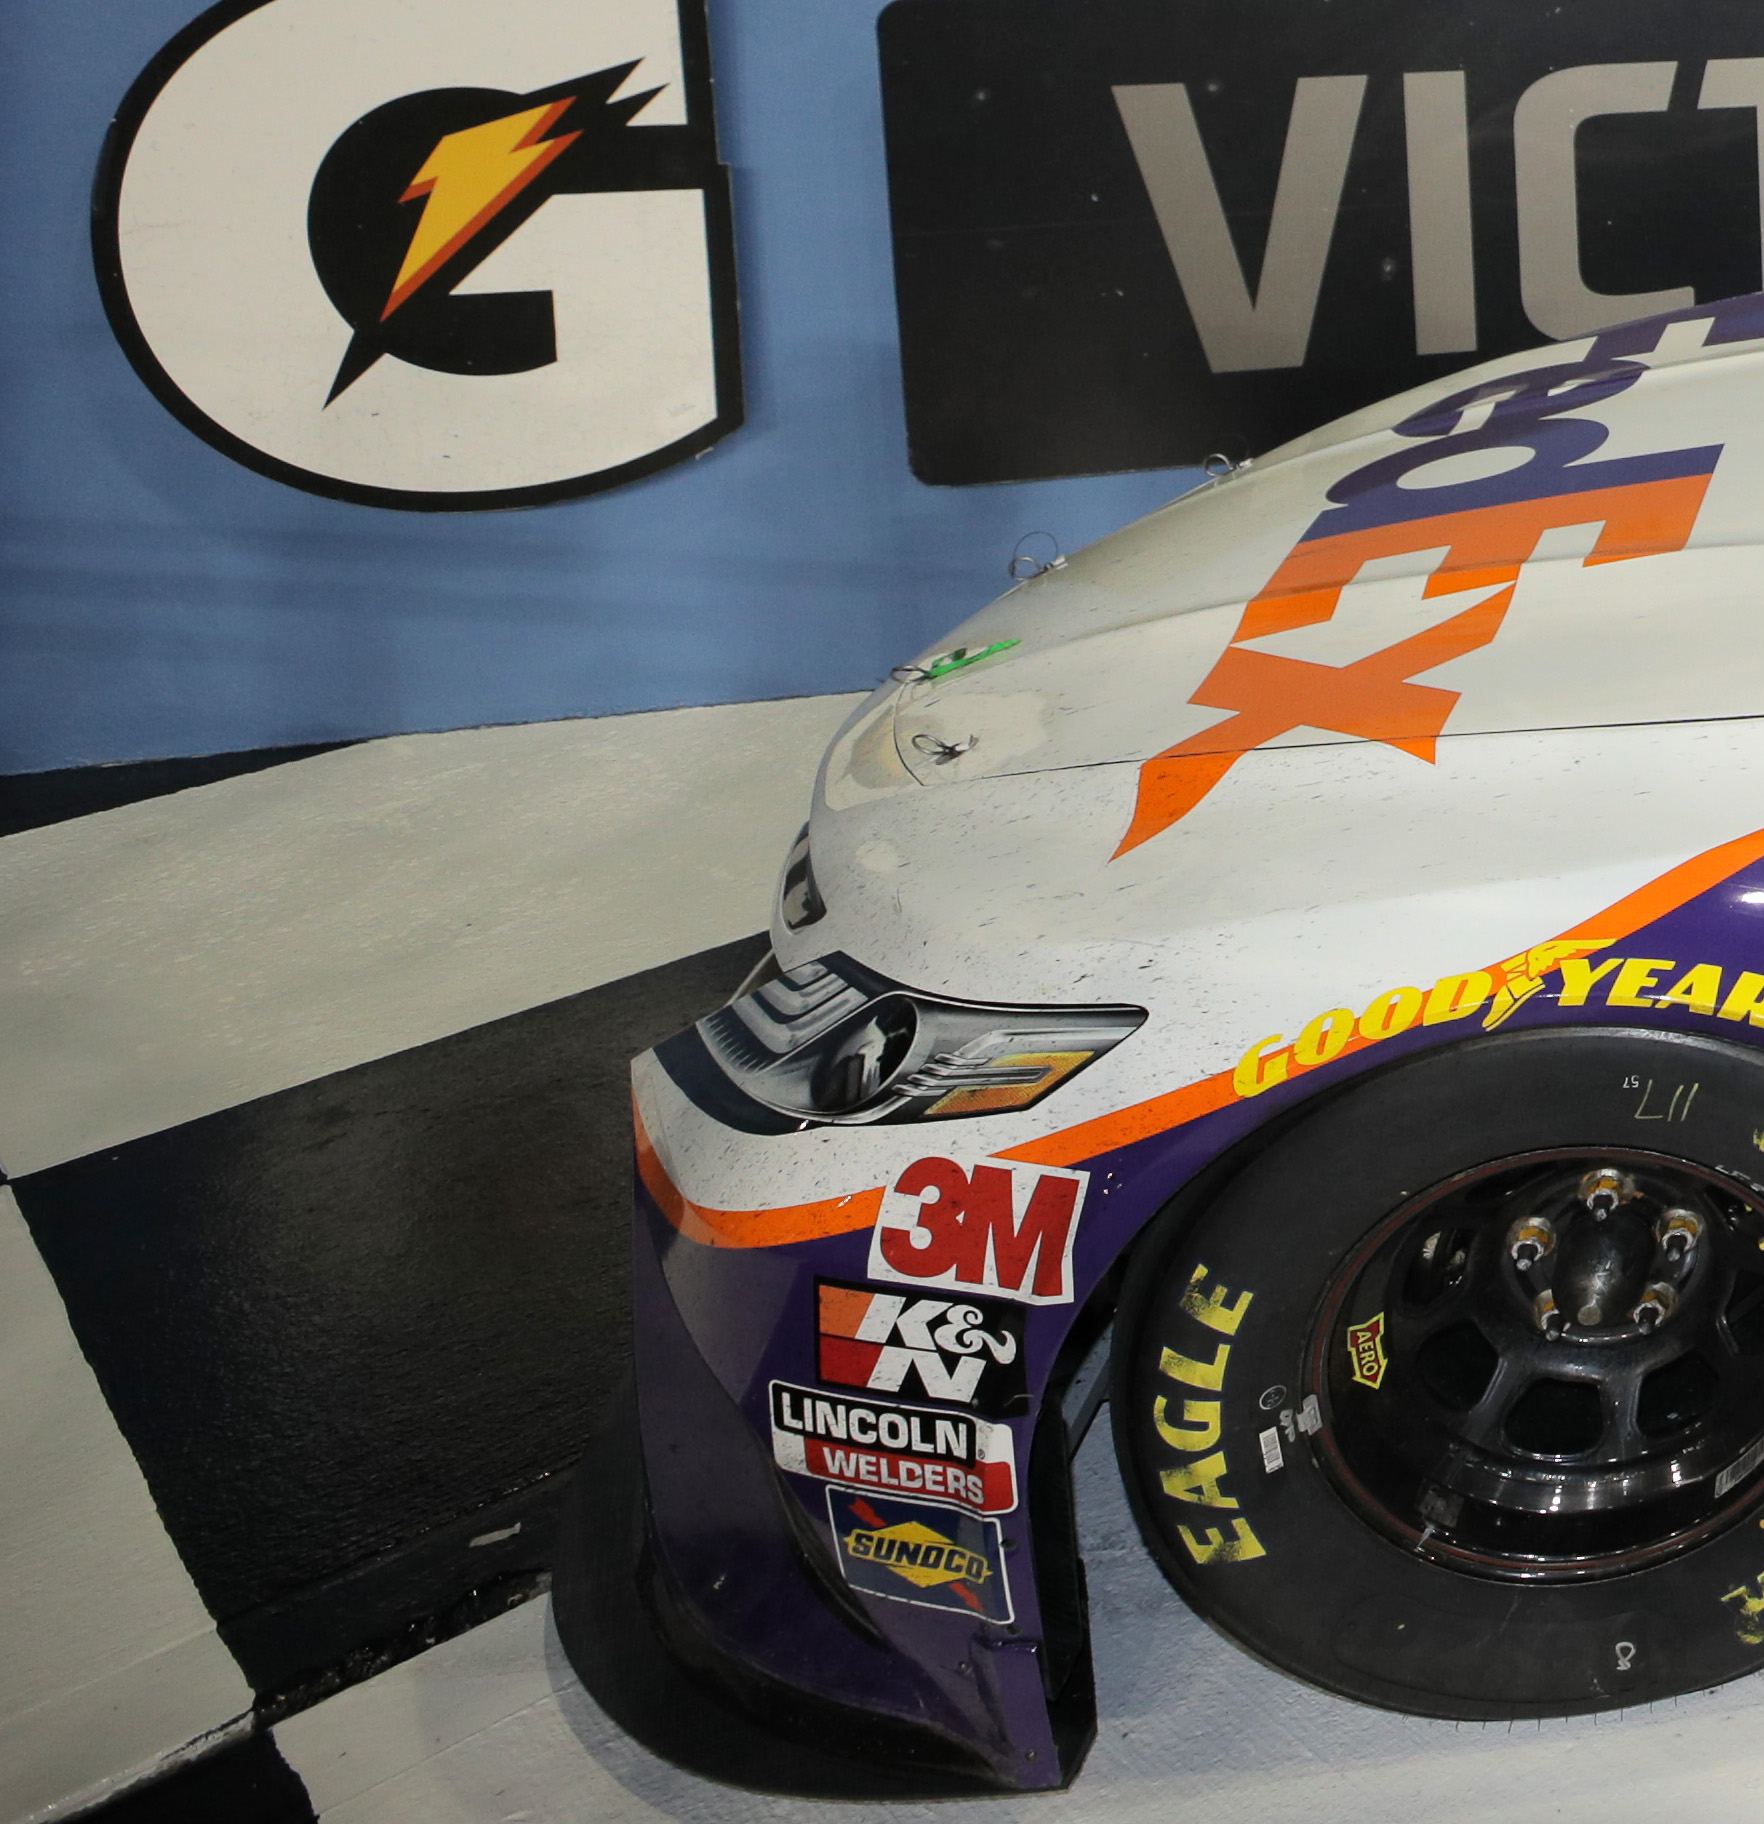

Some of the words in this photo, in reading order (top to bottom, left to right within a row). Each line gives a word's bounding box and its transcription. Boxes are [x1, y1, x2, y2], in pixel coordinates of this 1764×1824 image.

[880, 1157, 1080, 1296] 3M
[1357, 1331, 1377, 1375] AERO
[781, 1392, 968, 1459] LINCOLN
[1154, 1264, 1266, 1563] EAGLE
[823, 1448, 985, 1505] WELDERS
[851, 1532, 987, 1579] SUNOCO
